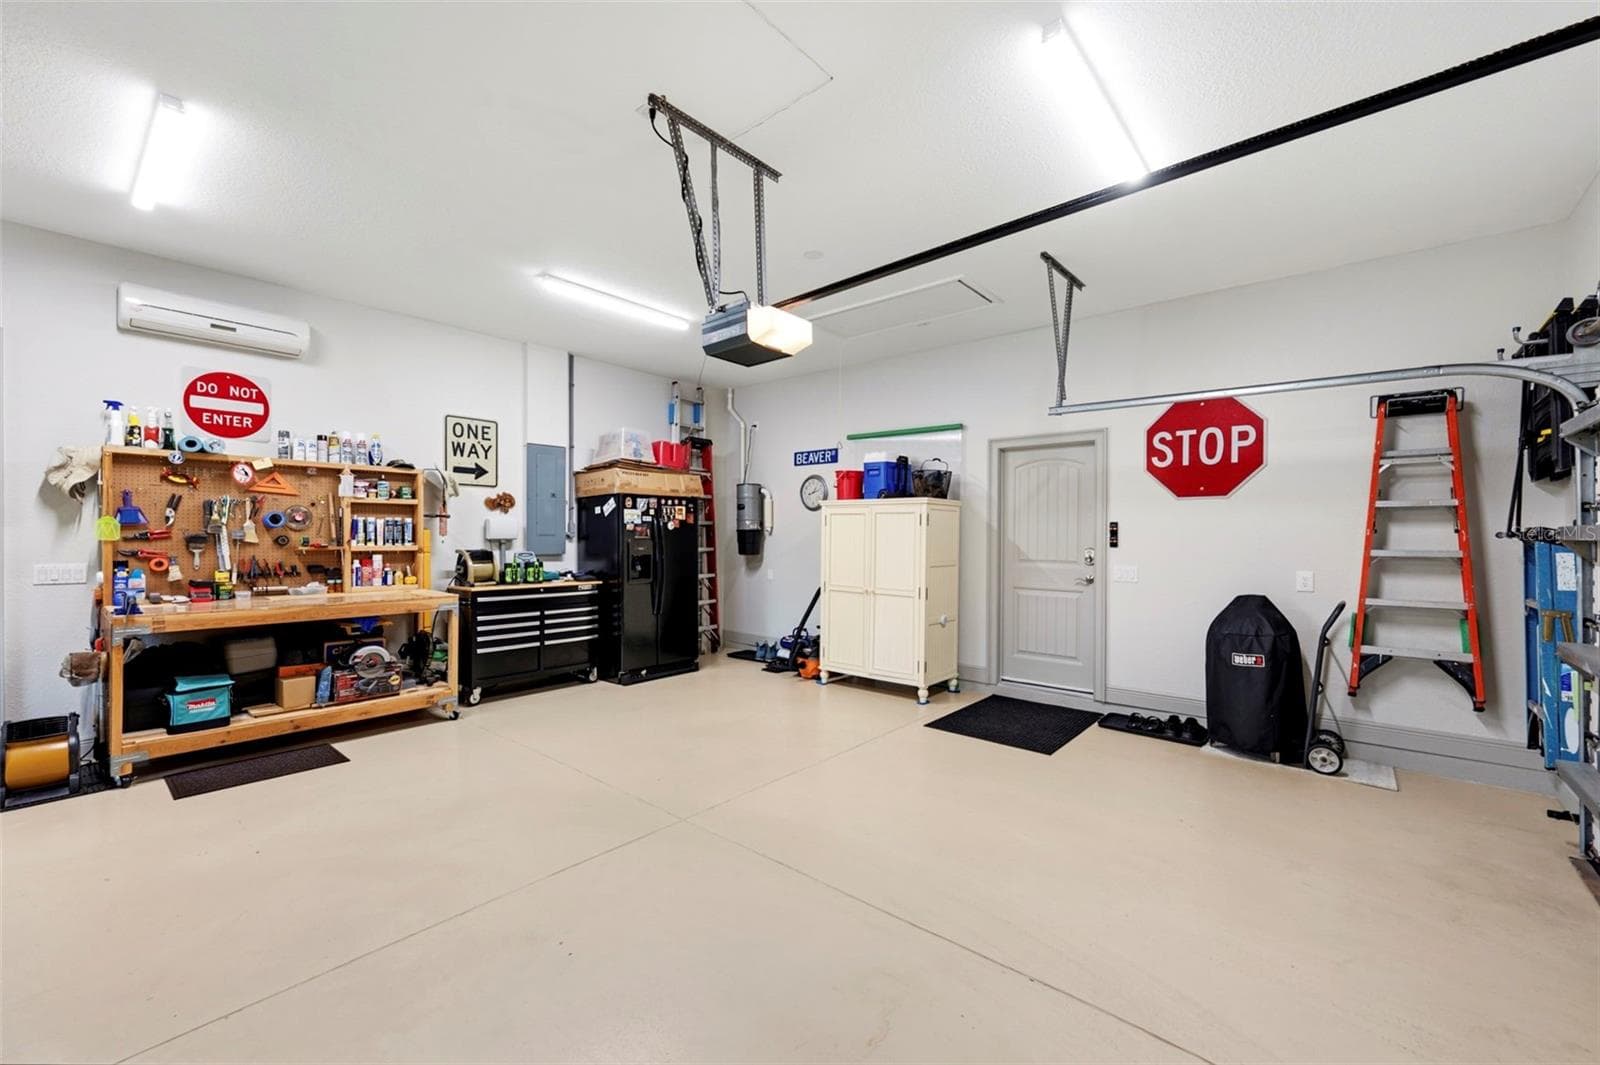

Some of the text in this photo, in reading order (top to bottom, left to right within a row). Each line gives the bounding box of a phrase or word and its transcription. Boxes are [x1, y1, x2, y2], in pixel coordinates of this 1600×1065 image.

[196, 381, 258, 400] DO NOT
[202, 412, 253, 428] ENTER
[452, 422, 492, 441] ONE
[451, 441, 492, 460] WAY
[1151, 424, 1257, 468] STOP
[796, 451, 832, 464] BEAVER
